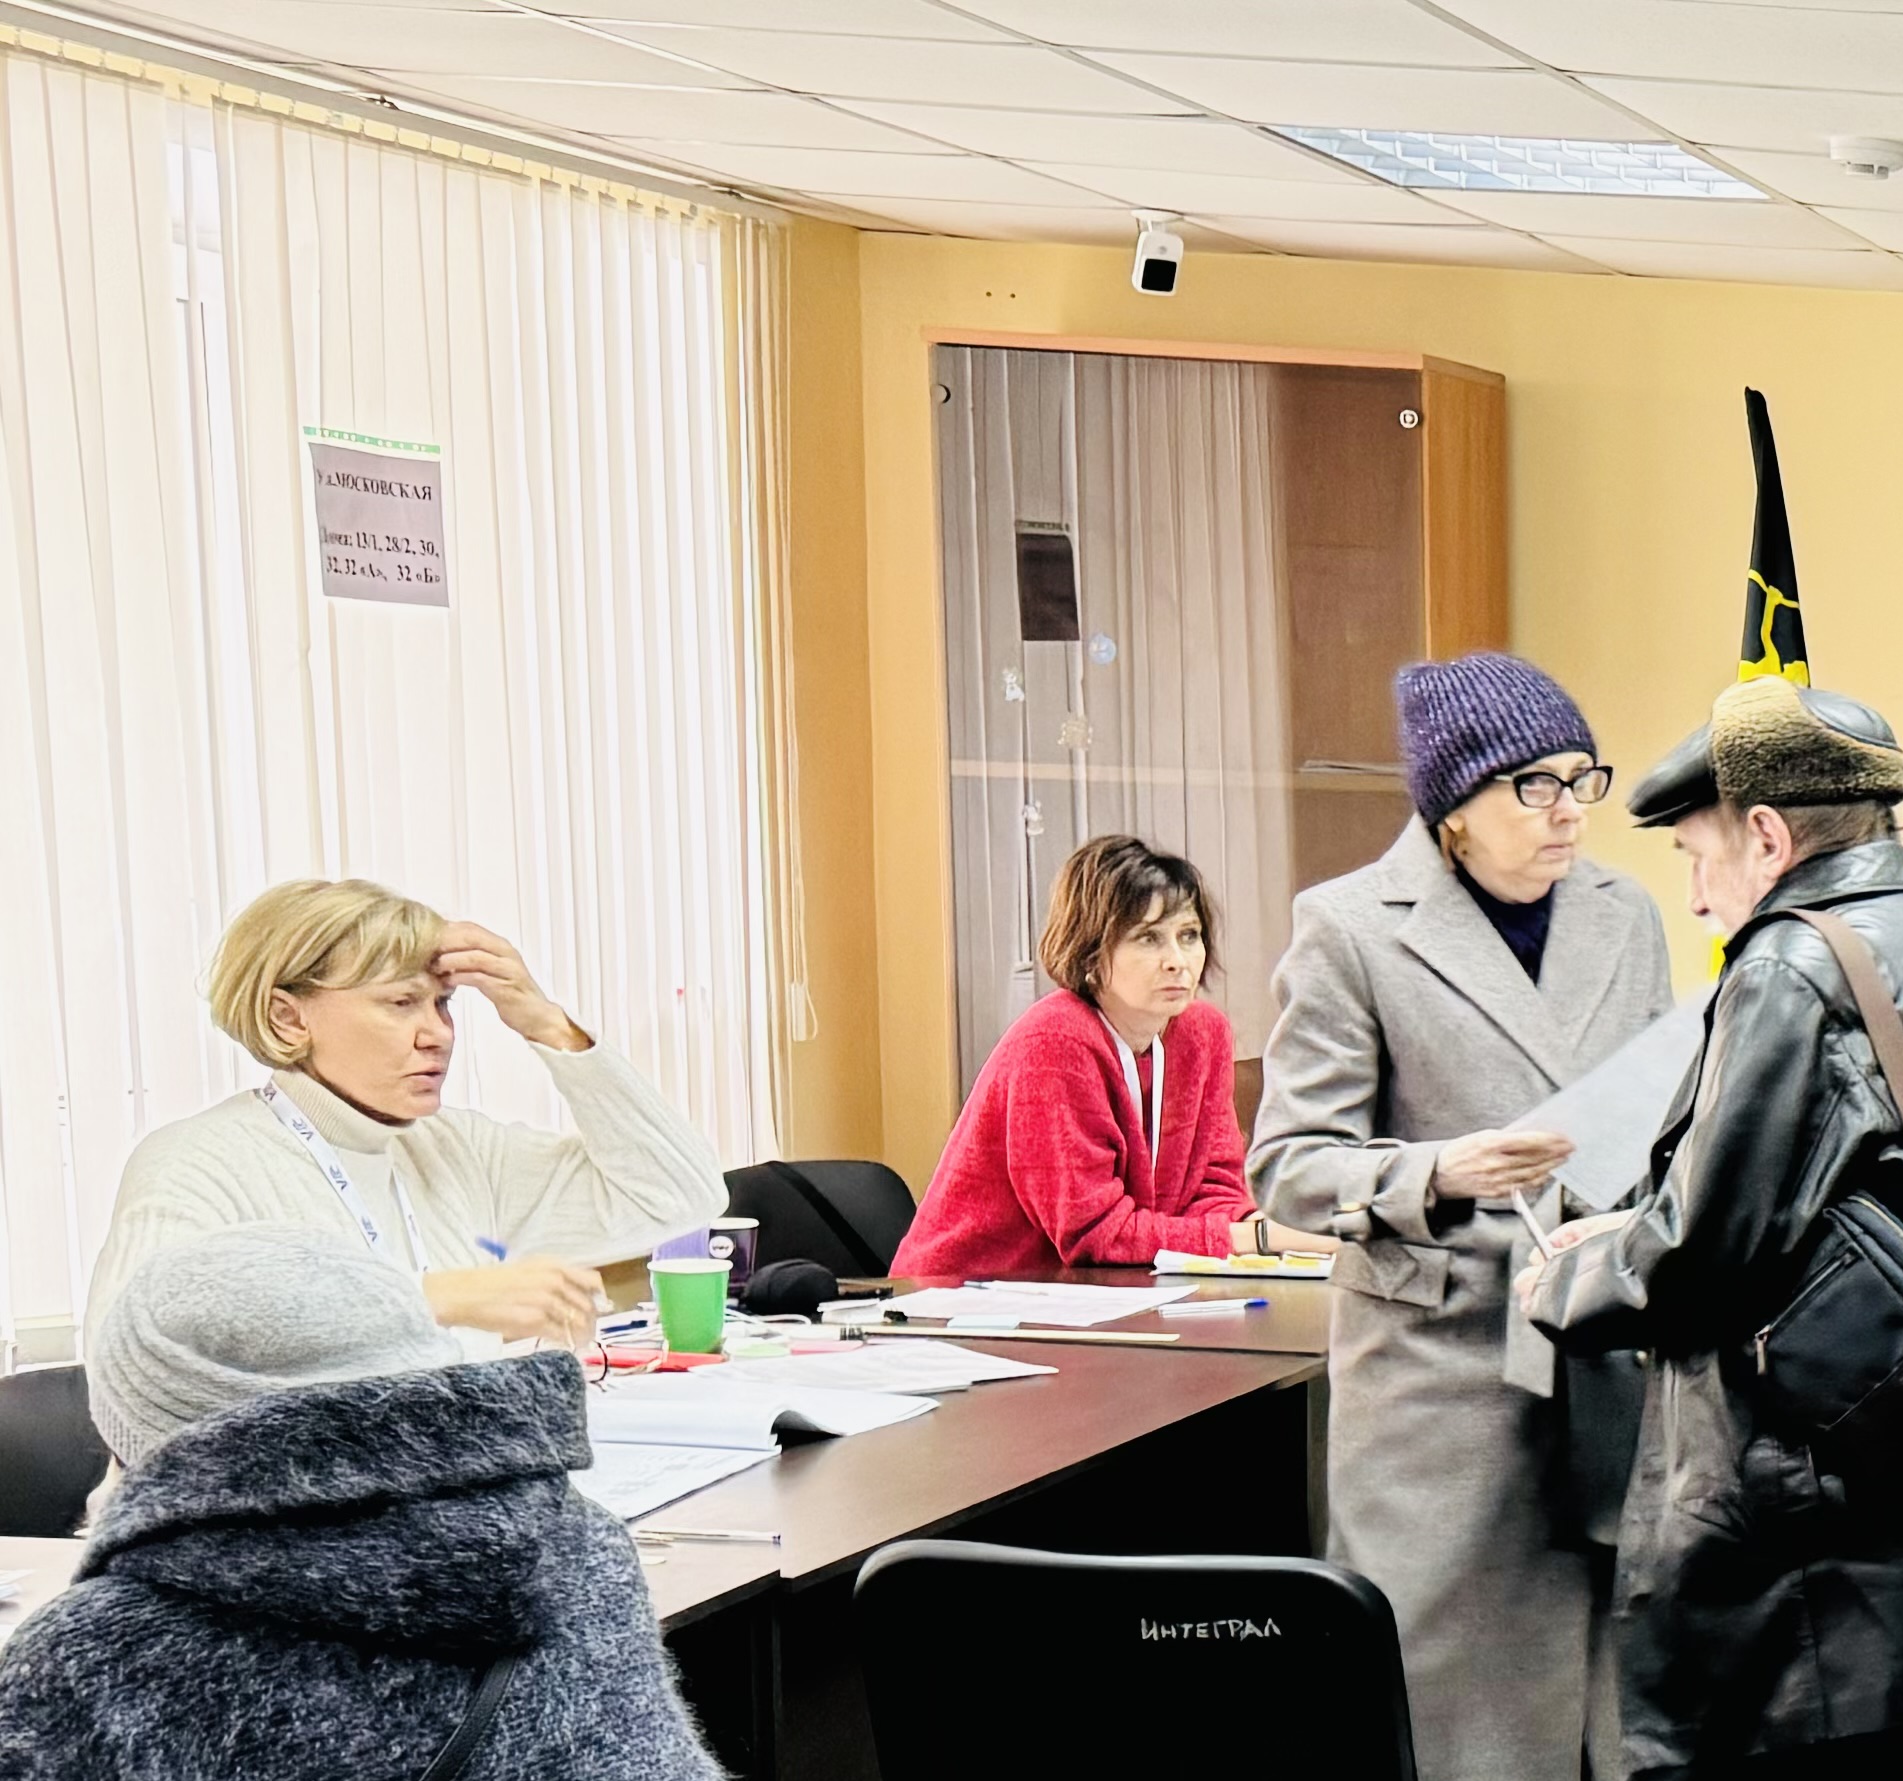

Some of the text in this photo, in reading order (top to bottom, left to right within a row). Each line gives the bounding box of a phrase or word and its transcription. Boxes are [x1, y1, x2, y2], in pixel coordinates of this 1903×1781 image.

[345, 558, 357, 576] 32
[397, 564, 412, 582] 32
[1140, 1616, 1282, 1642] ИНТЕГРАЛ
